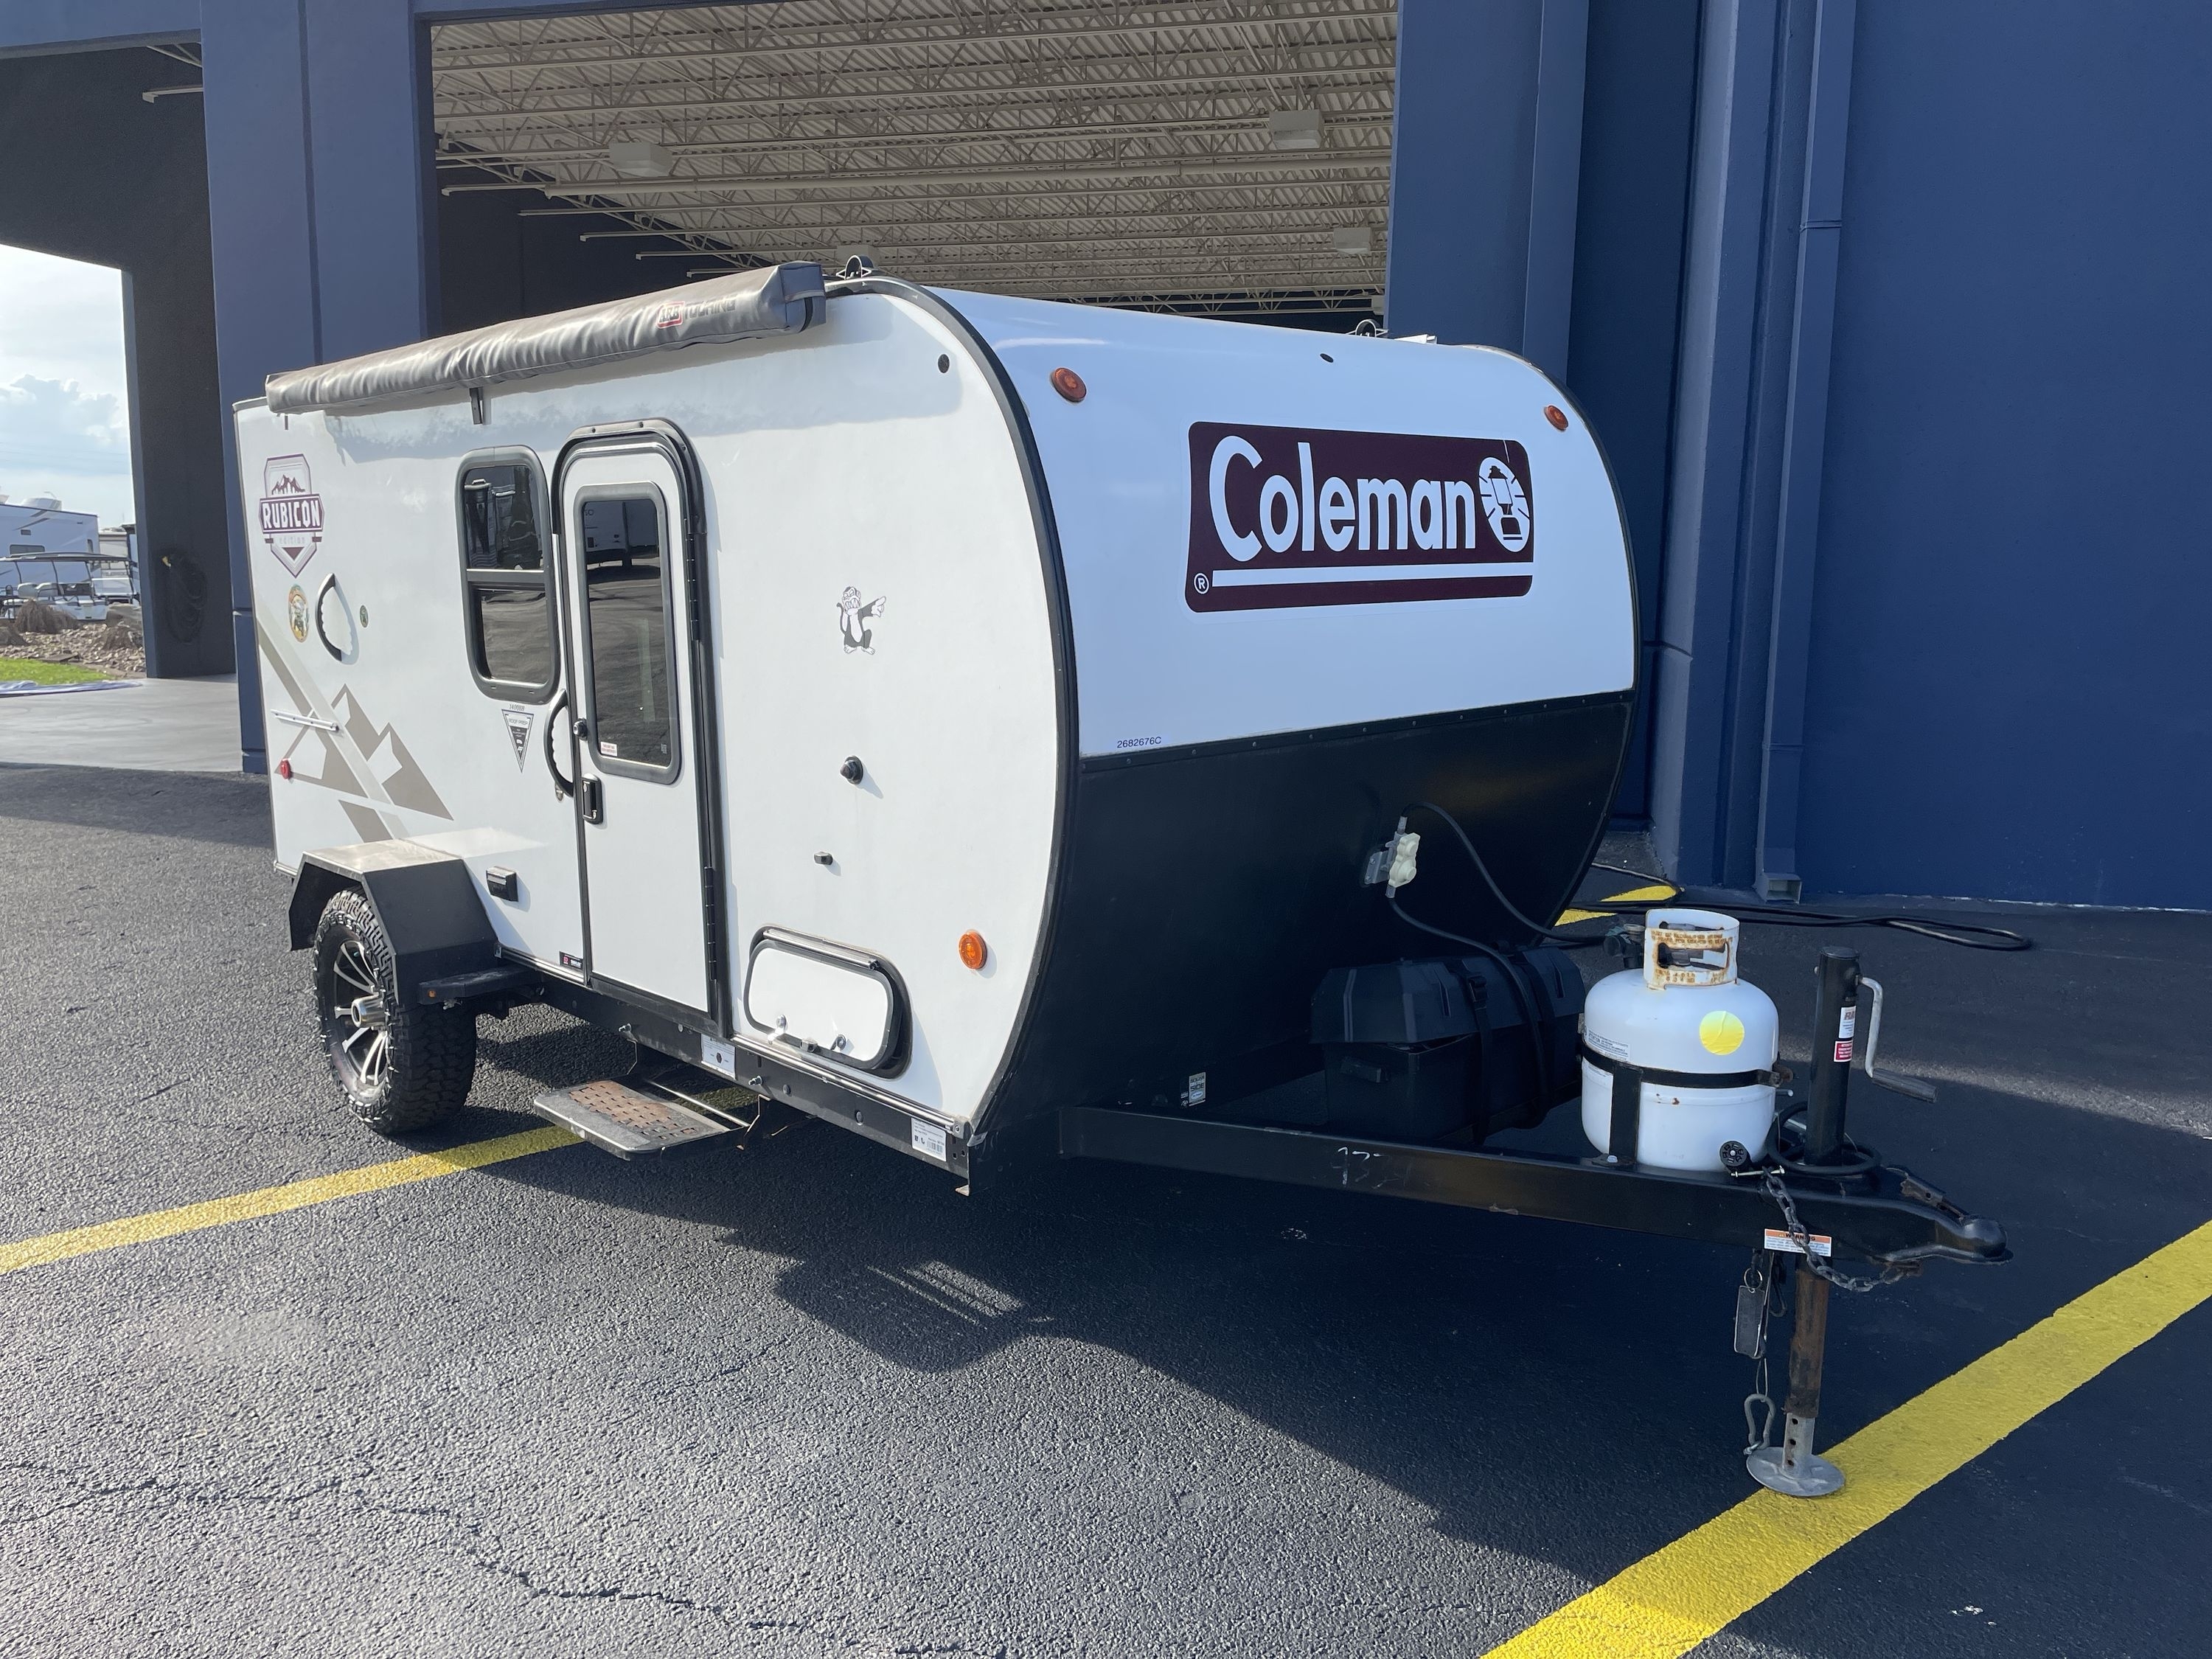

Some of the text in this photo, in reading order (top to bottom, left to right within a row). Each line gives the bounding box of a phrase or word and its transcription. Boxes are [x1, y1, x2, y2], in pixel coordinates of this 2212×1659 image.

[1208, 435, 1476, 562] Coleman
[262, 501, 320, 528] RUBICON
[1116, 736, 1162, 748] 2682676C
[1785, 1232, 1816, 1241] WRNG
